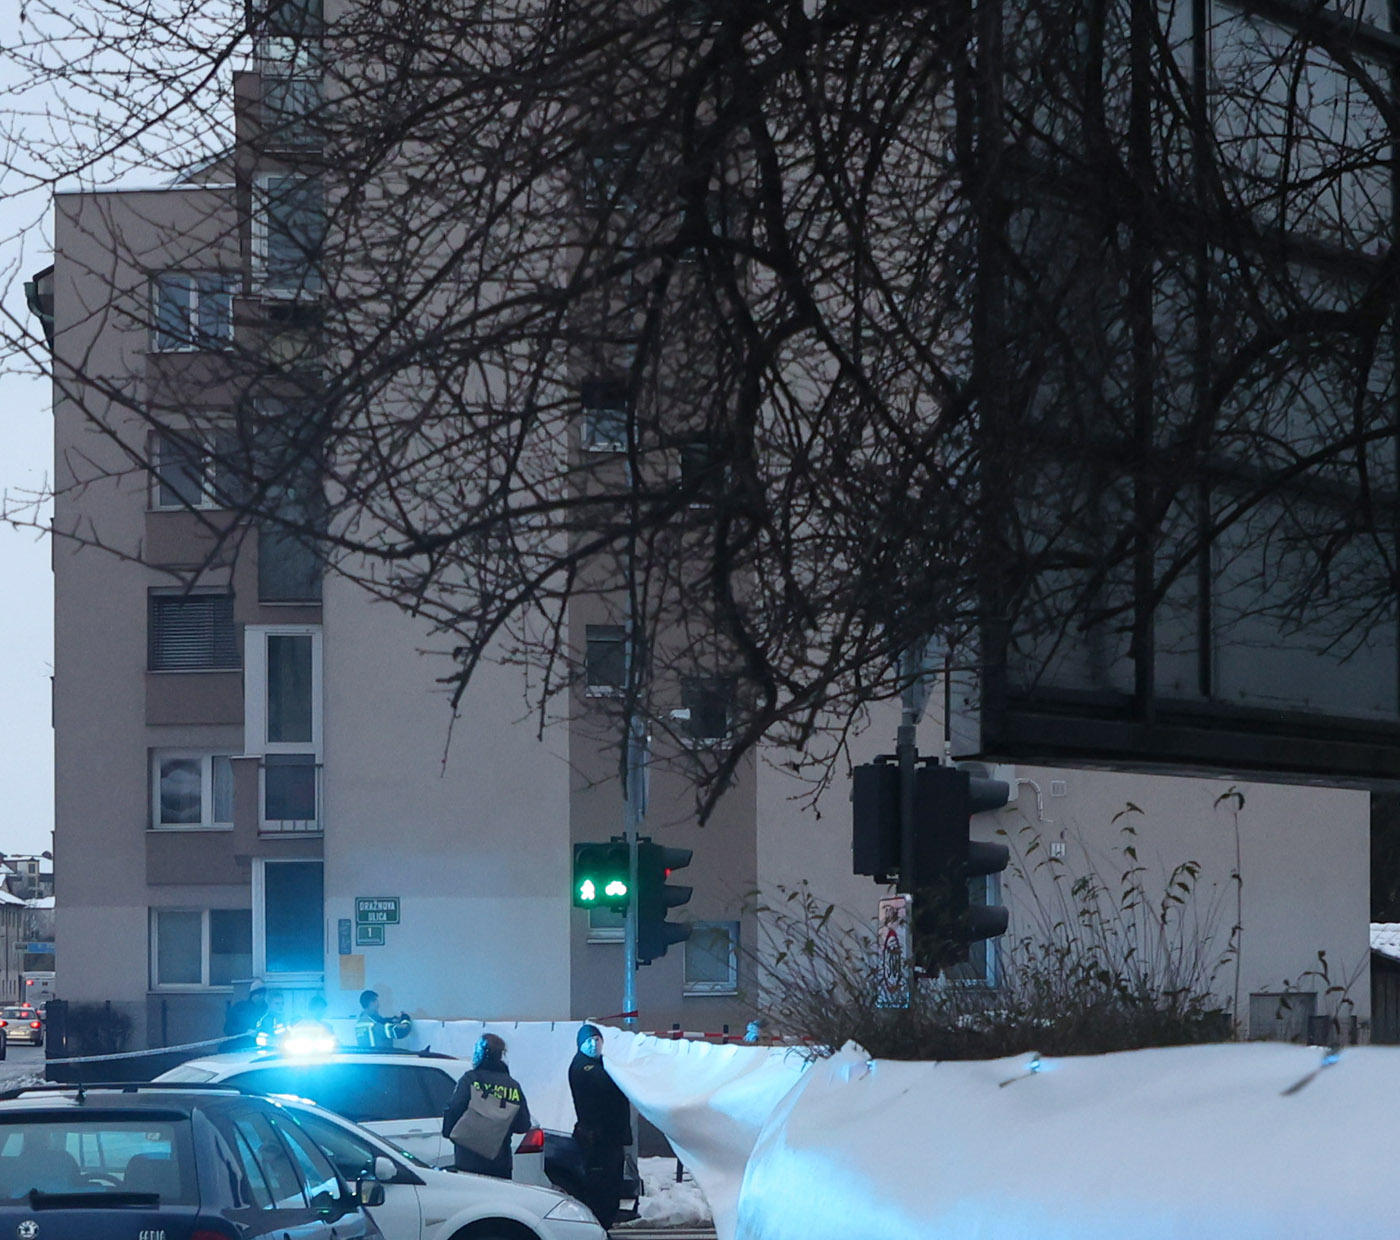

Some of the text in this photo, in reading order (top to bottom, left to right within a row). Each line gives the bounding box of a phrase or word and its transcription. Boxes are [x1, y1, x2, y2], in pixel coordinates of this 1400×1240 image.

[367, 912, 388, 921] ULICA
[367, 927, 373, 938] 1
[473, 1081, 520, 1102] PICIJA
